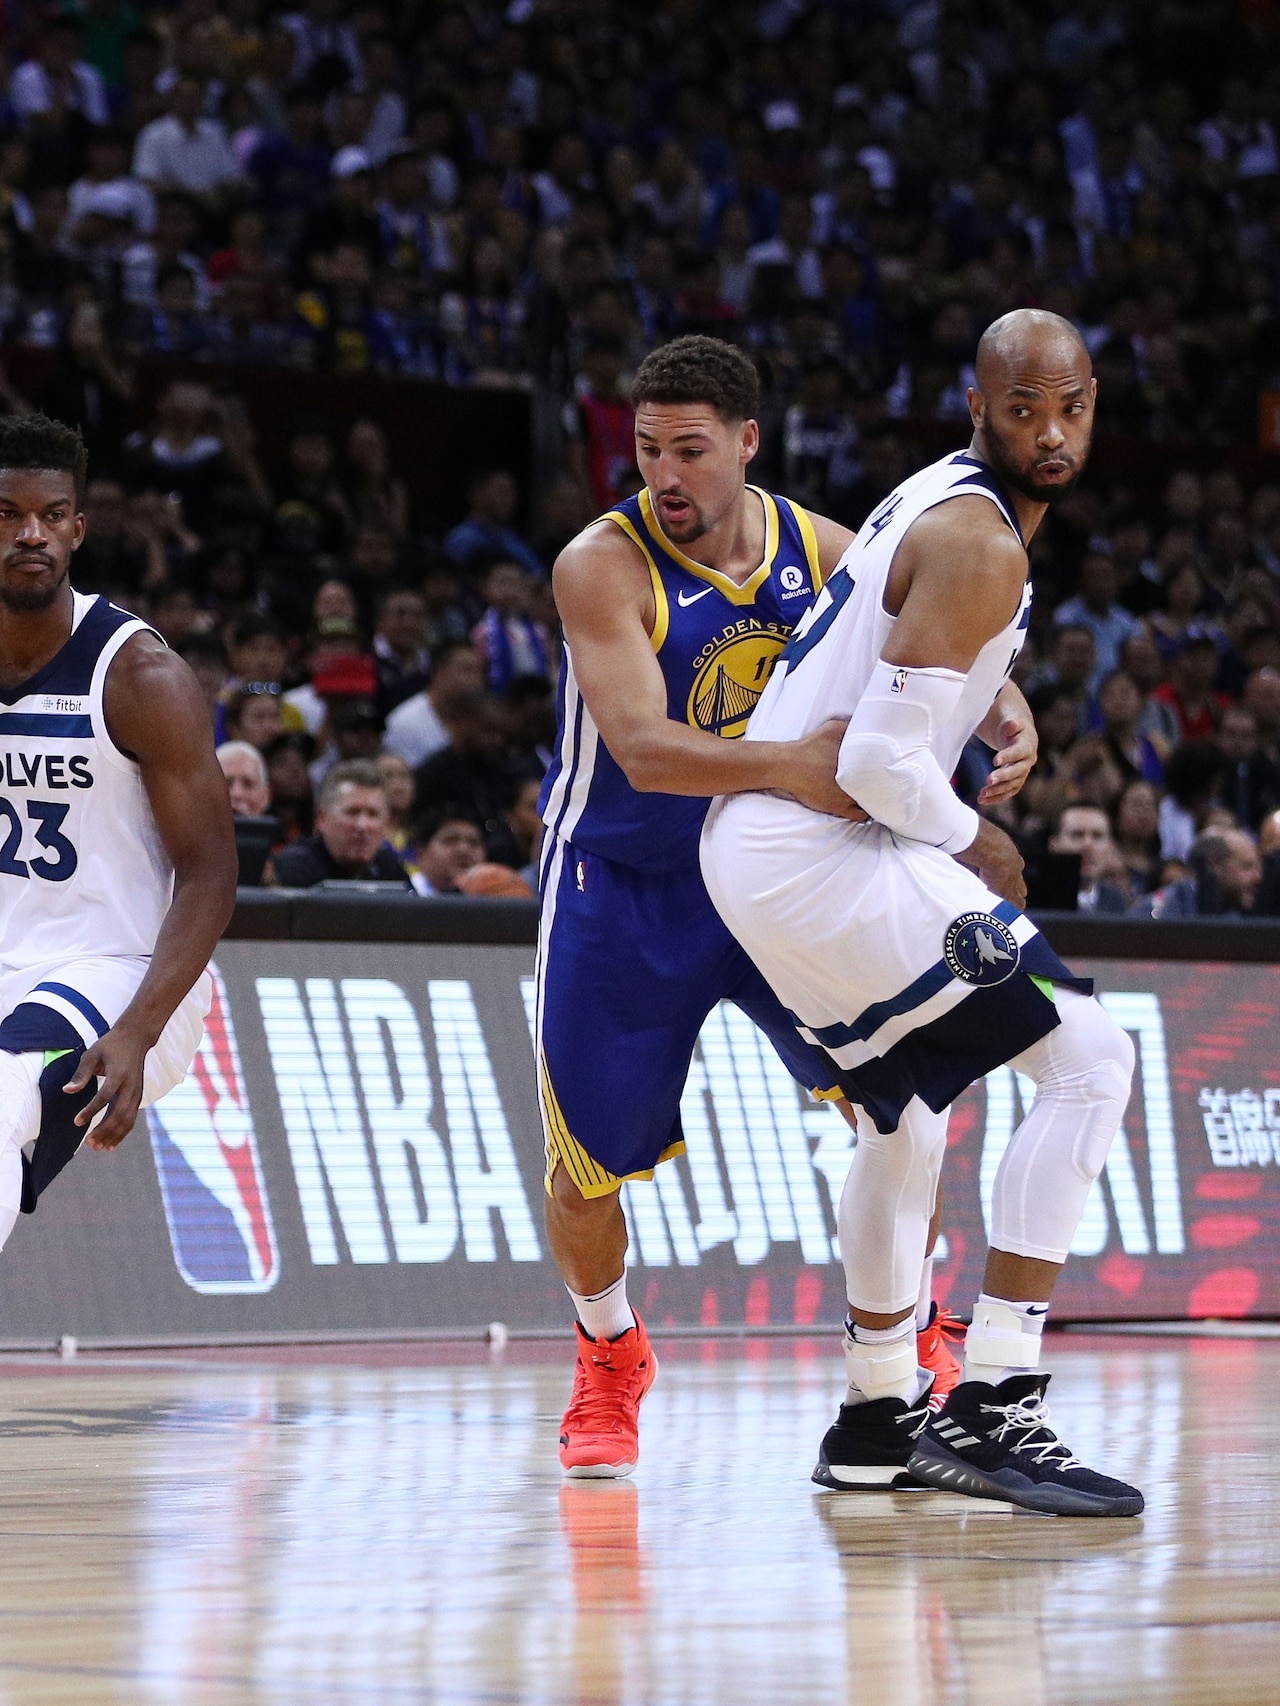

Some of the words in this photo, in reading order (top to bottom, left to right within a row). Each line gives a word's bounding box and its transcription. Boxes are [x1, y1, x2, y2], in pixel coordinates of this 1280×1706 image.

[781, 587, 811, 600] Rakuten
[692, 617, 762, 669] GOLDEN
[56, 698, 83, 712] fitbit
[945, 927, 970, 980] MINNESOTA
[956, 913, 1017, 951] TIMBERWOLVES
[255, 977, 543, 1266] NBA
